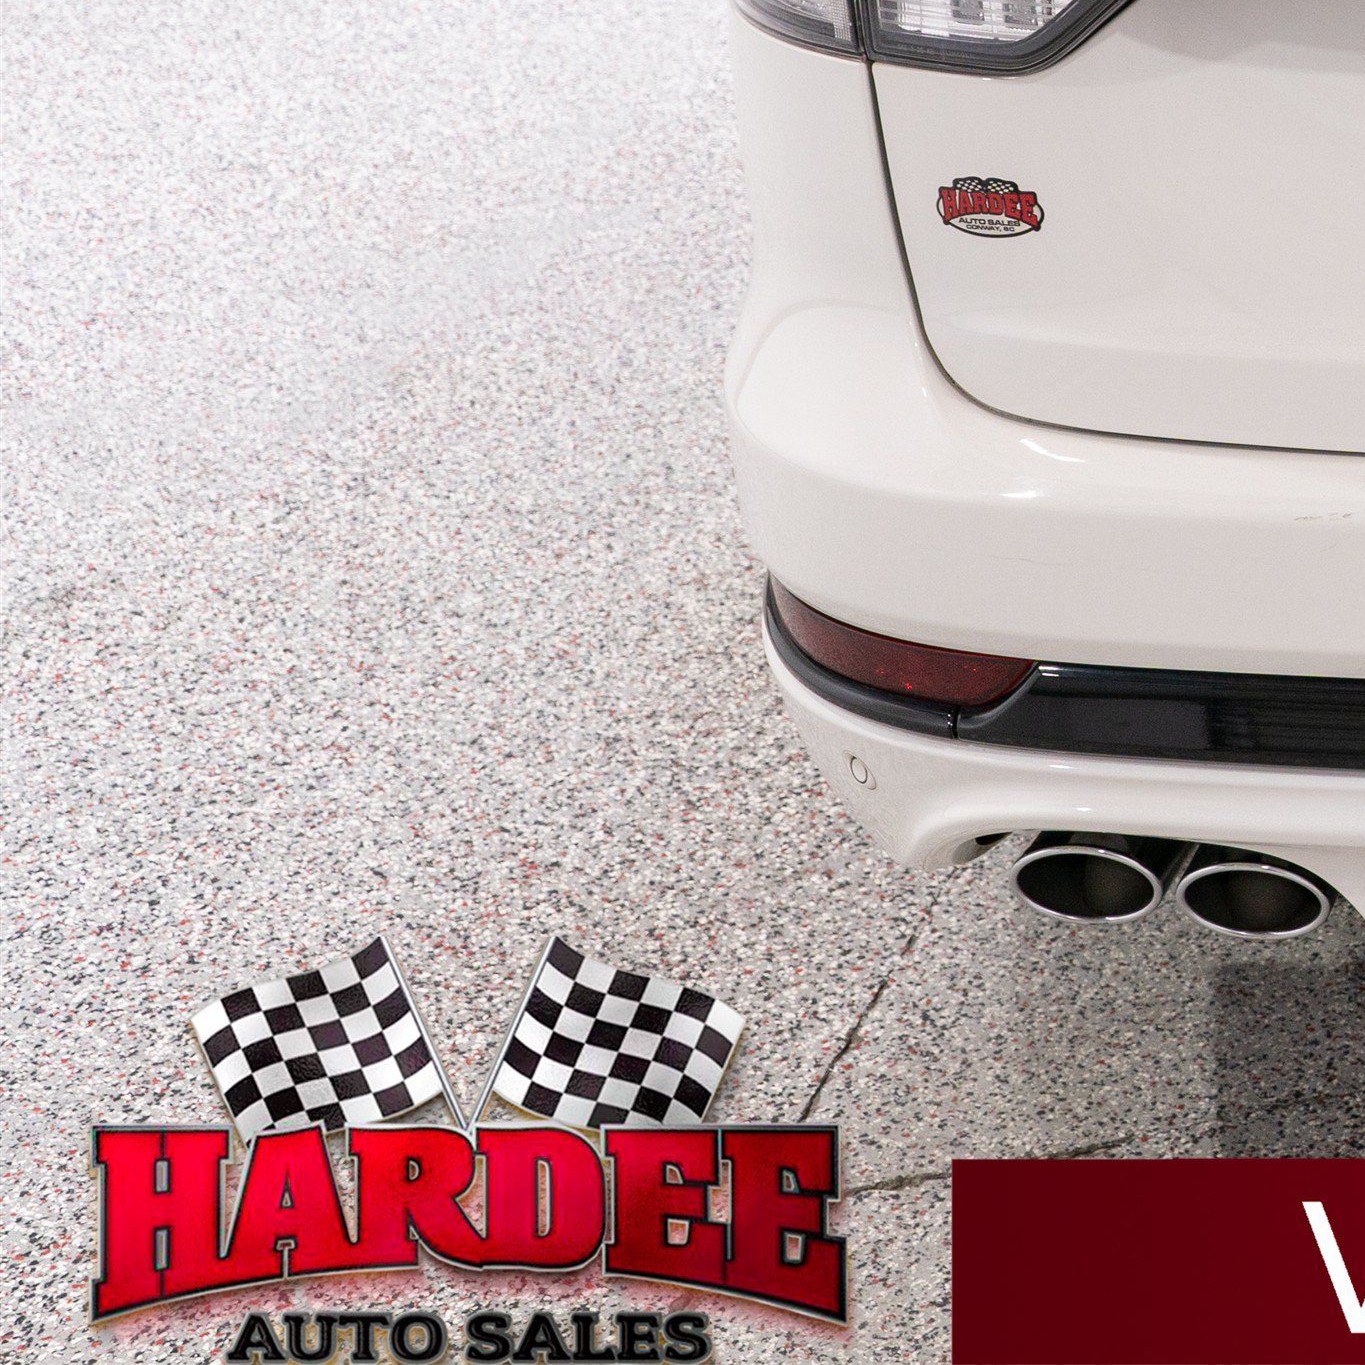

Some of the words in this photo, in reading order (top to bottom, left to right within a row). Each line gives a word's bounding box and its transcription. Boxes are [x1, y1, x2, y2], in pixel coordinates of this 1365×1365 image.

[940, 187, 1040, 230] HARDEE
[958, 217, 986, 225] AUTO
[987, 219, 1021, 227] SALES
[966, 224, 1002, 233] CONWAY,
